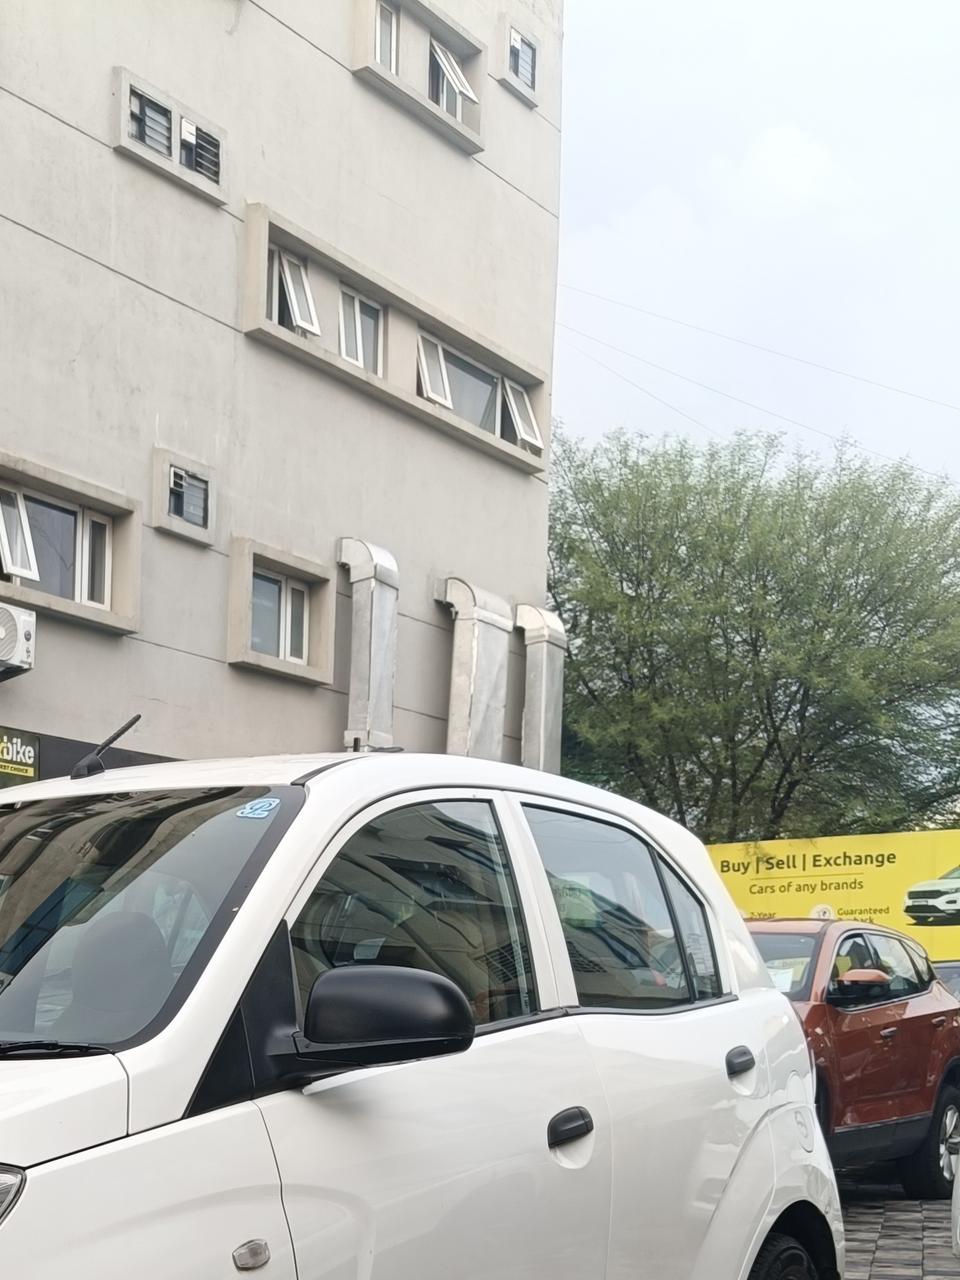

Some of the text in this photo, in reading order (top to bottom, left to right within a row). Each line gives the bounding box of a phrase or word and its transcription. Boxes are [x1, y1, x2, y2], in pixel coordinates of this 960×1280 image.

[720, 860, 751, 875] Buy
[765, 855, 797, 870] Sell
[812, 851, 897, 868] Exchange
[749, 879, 864, 895] Cars of any brands
[837, 906, 890, 916] Guaranteed
